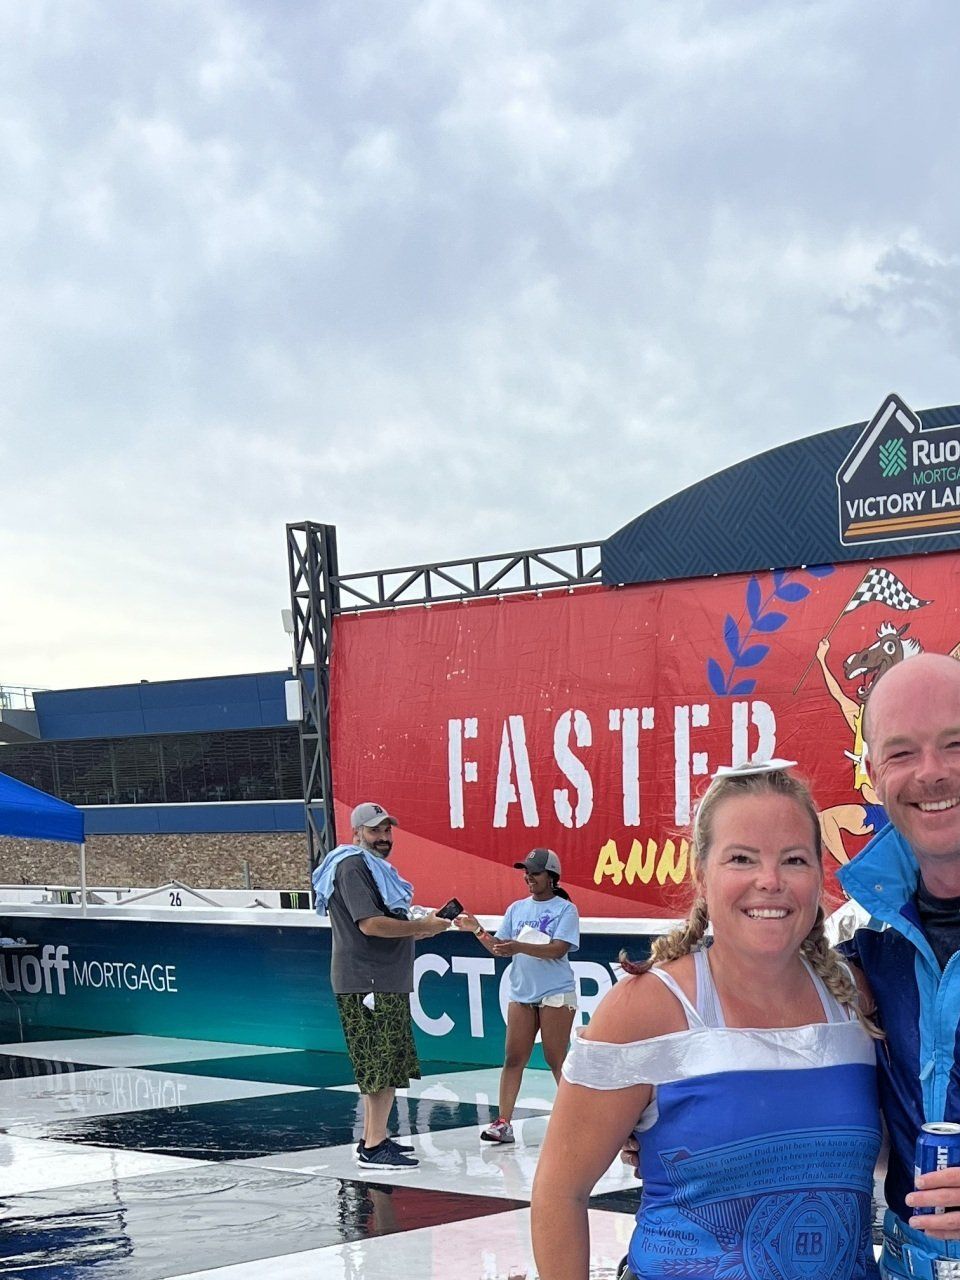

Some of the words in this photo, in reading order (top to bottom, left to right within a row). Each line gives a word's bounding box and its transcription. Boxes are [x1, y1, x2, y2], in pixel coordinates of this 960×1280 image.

[845, 491, 926, 519] VICTORY
[593, 837, 697, 886] ANN
[169, 892, 182, 907] 26
[0, 944, 69, 995] uoff
[72, 960, 178, 993] MORTGAGE
[720, 1152, 752, 1167] famous
[755, 1155, 779, 1167] which
[819, 1150, 835, 1158] and
[777, 1173, 800, 1183] clean
[795, 1231, 824, 1257] AB
